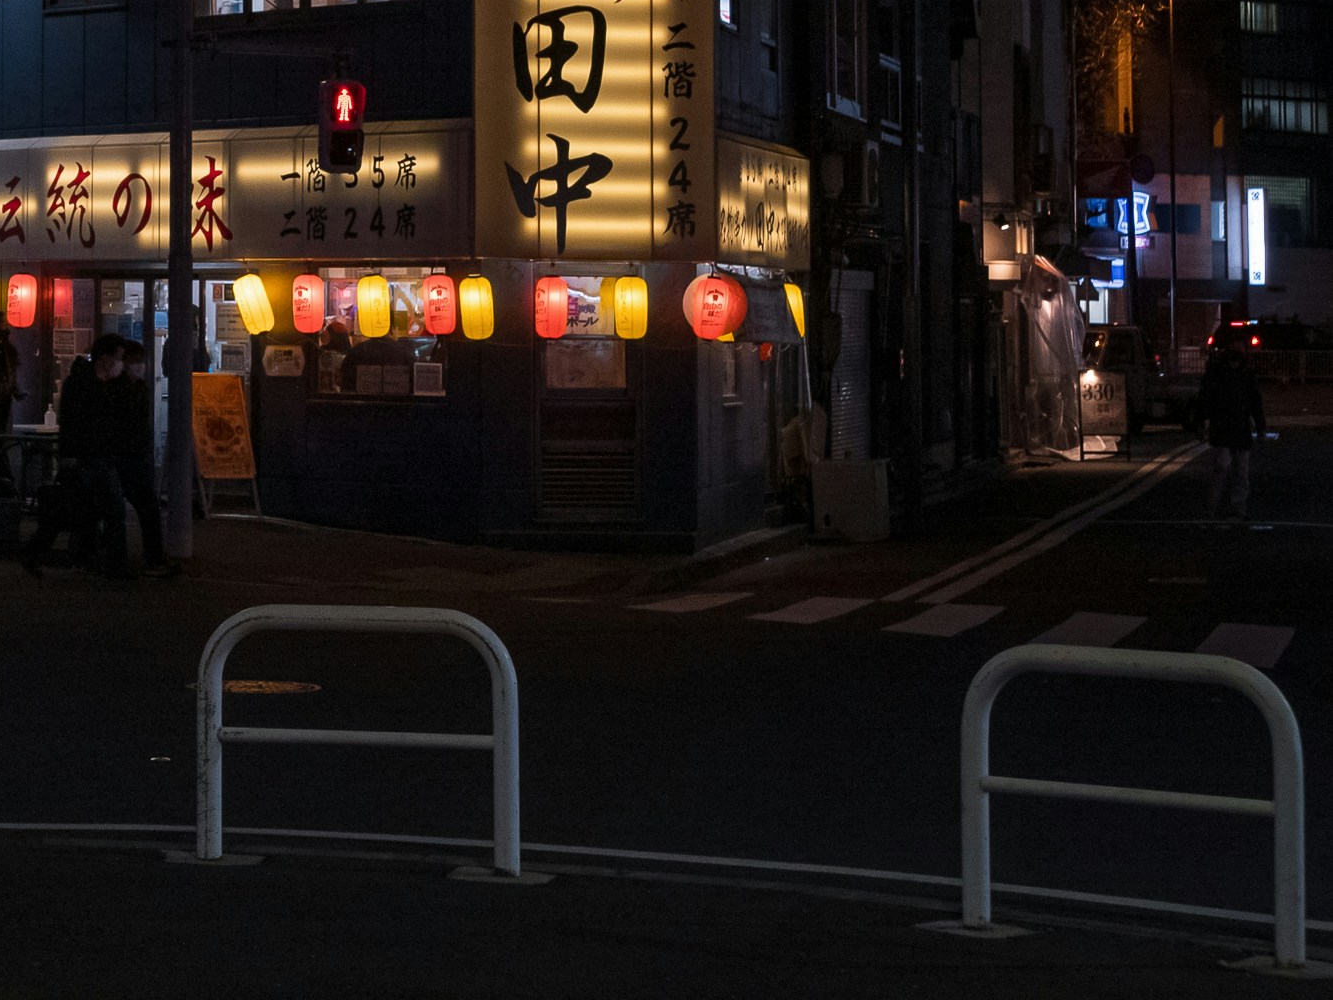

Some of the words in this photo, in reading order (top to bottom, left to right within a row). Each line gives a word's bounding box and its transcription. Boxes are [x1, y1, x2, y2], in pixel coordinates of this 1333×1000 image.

[504, 4, 614, 255] 田中
[662, 21, 697, 239] 二階24席
[280, 203, 416, 241] 二階24席
[1083, 384, 1114, 401] 330
